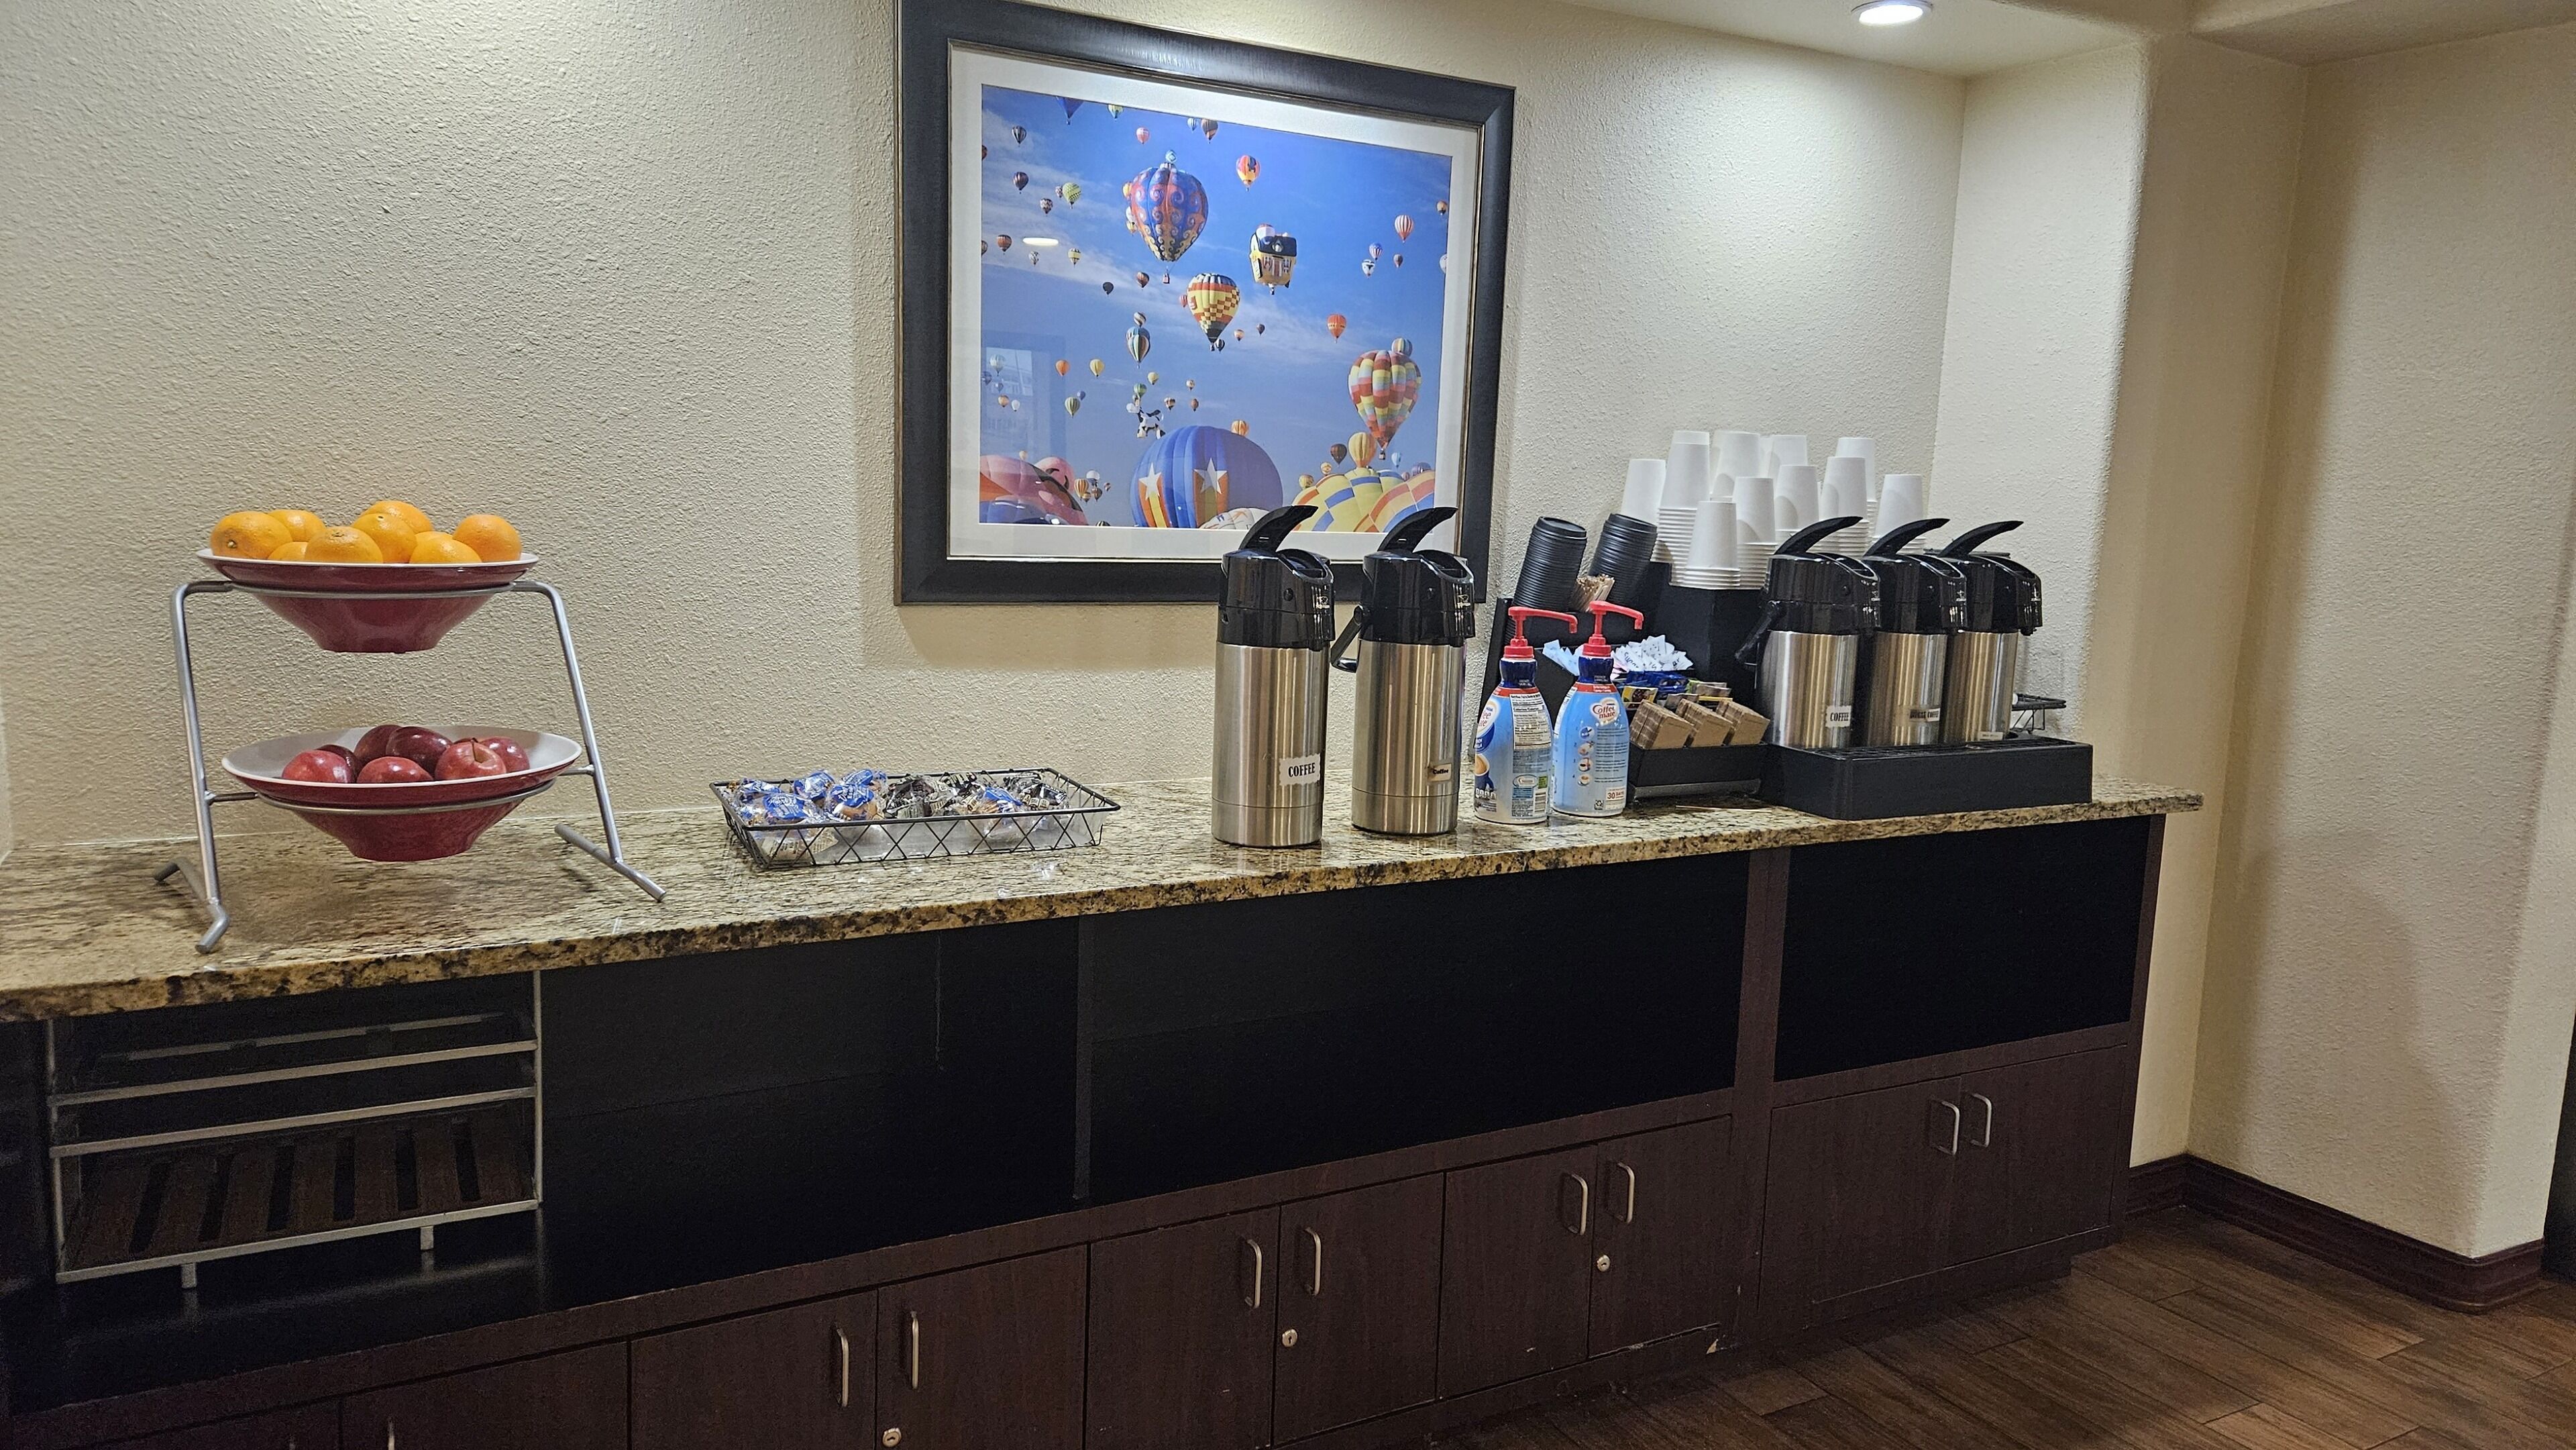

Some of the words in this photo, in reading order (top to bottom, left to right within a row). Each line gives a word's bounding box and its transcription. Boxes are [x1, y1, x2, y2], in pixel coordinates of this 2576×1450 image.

[1592, 704, 1615, 715] Coffee
[1599, 711, 1615, 719] mate
[1830, 712, 1849, 722] COFFEE
[1288, 762, 1316, 778] COFFEE
